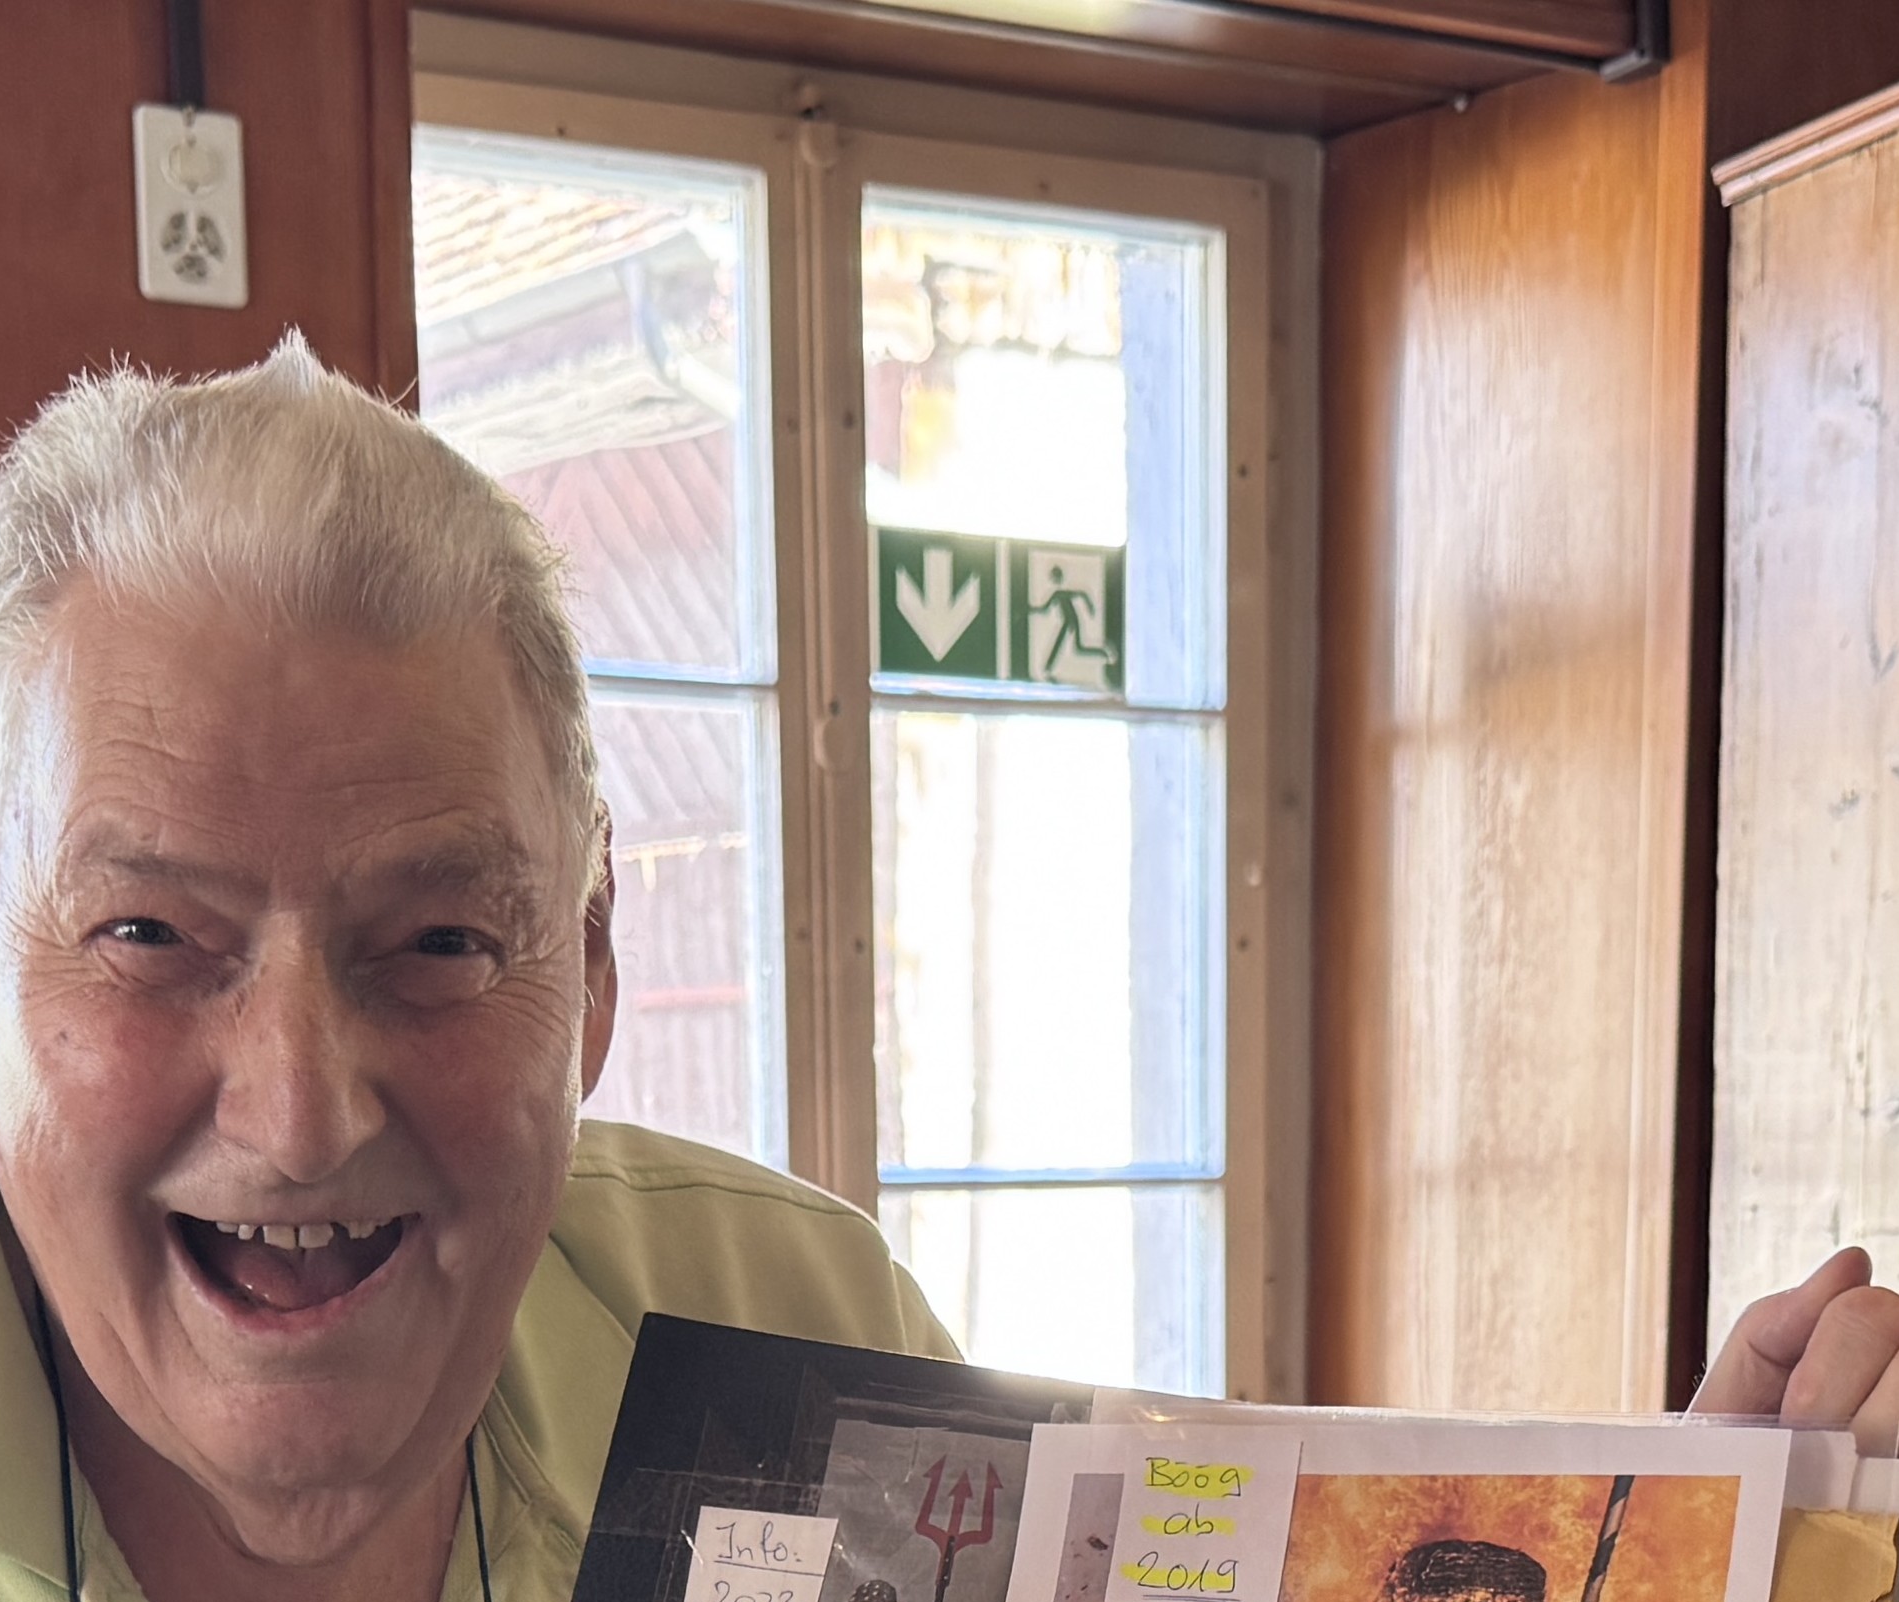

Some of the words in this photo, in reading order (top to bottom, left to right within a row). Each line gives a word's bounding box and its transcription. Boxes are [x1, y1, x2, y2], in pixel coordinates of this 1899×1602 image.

[1164, 1503, 1214, 1535] ab
[716, 1521, 801, 1565] Info:
[1137, 1552, 1239, 1592] 2019
